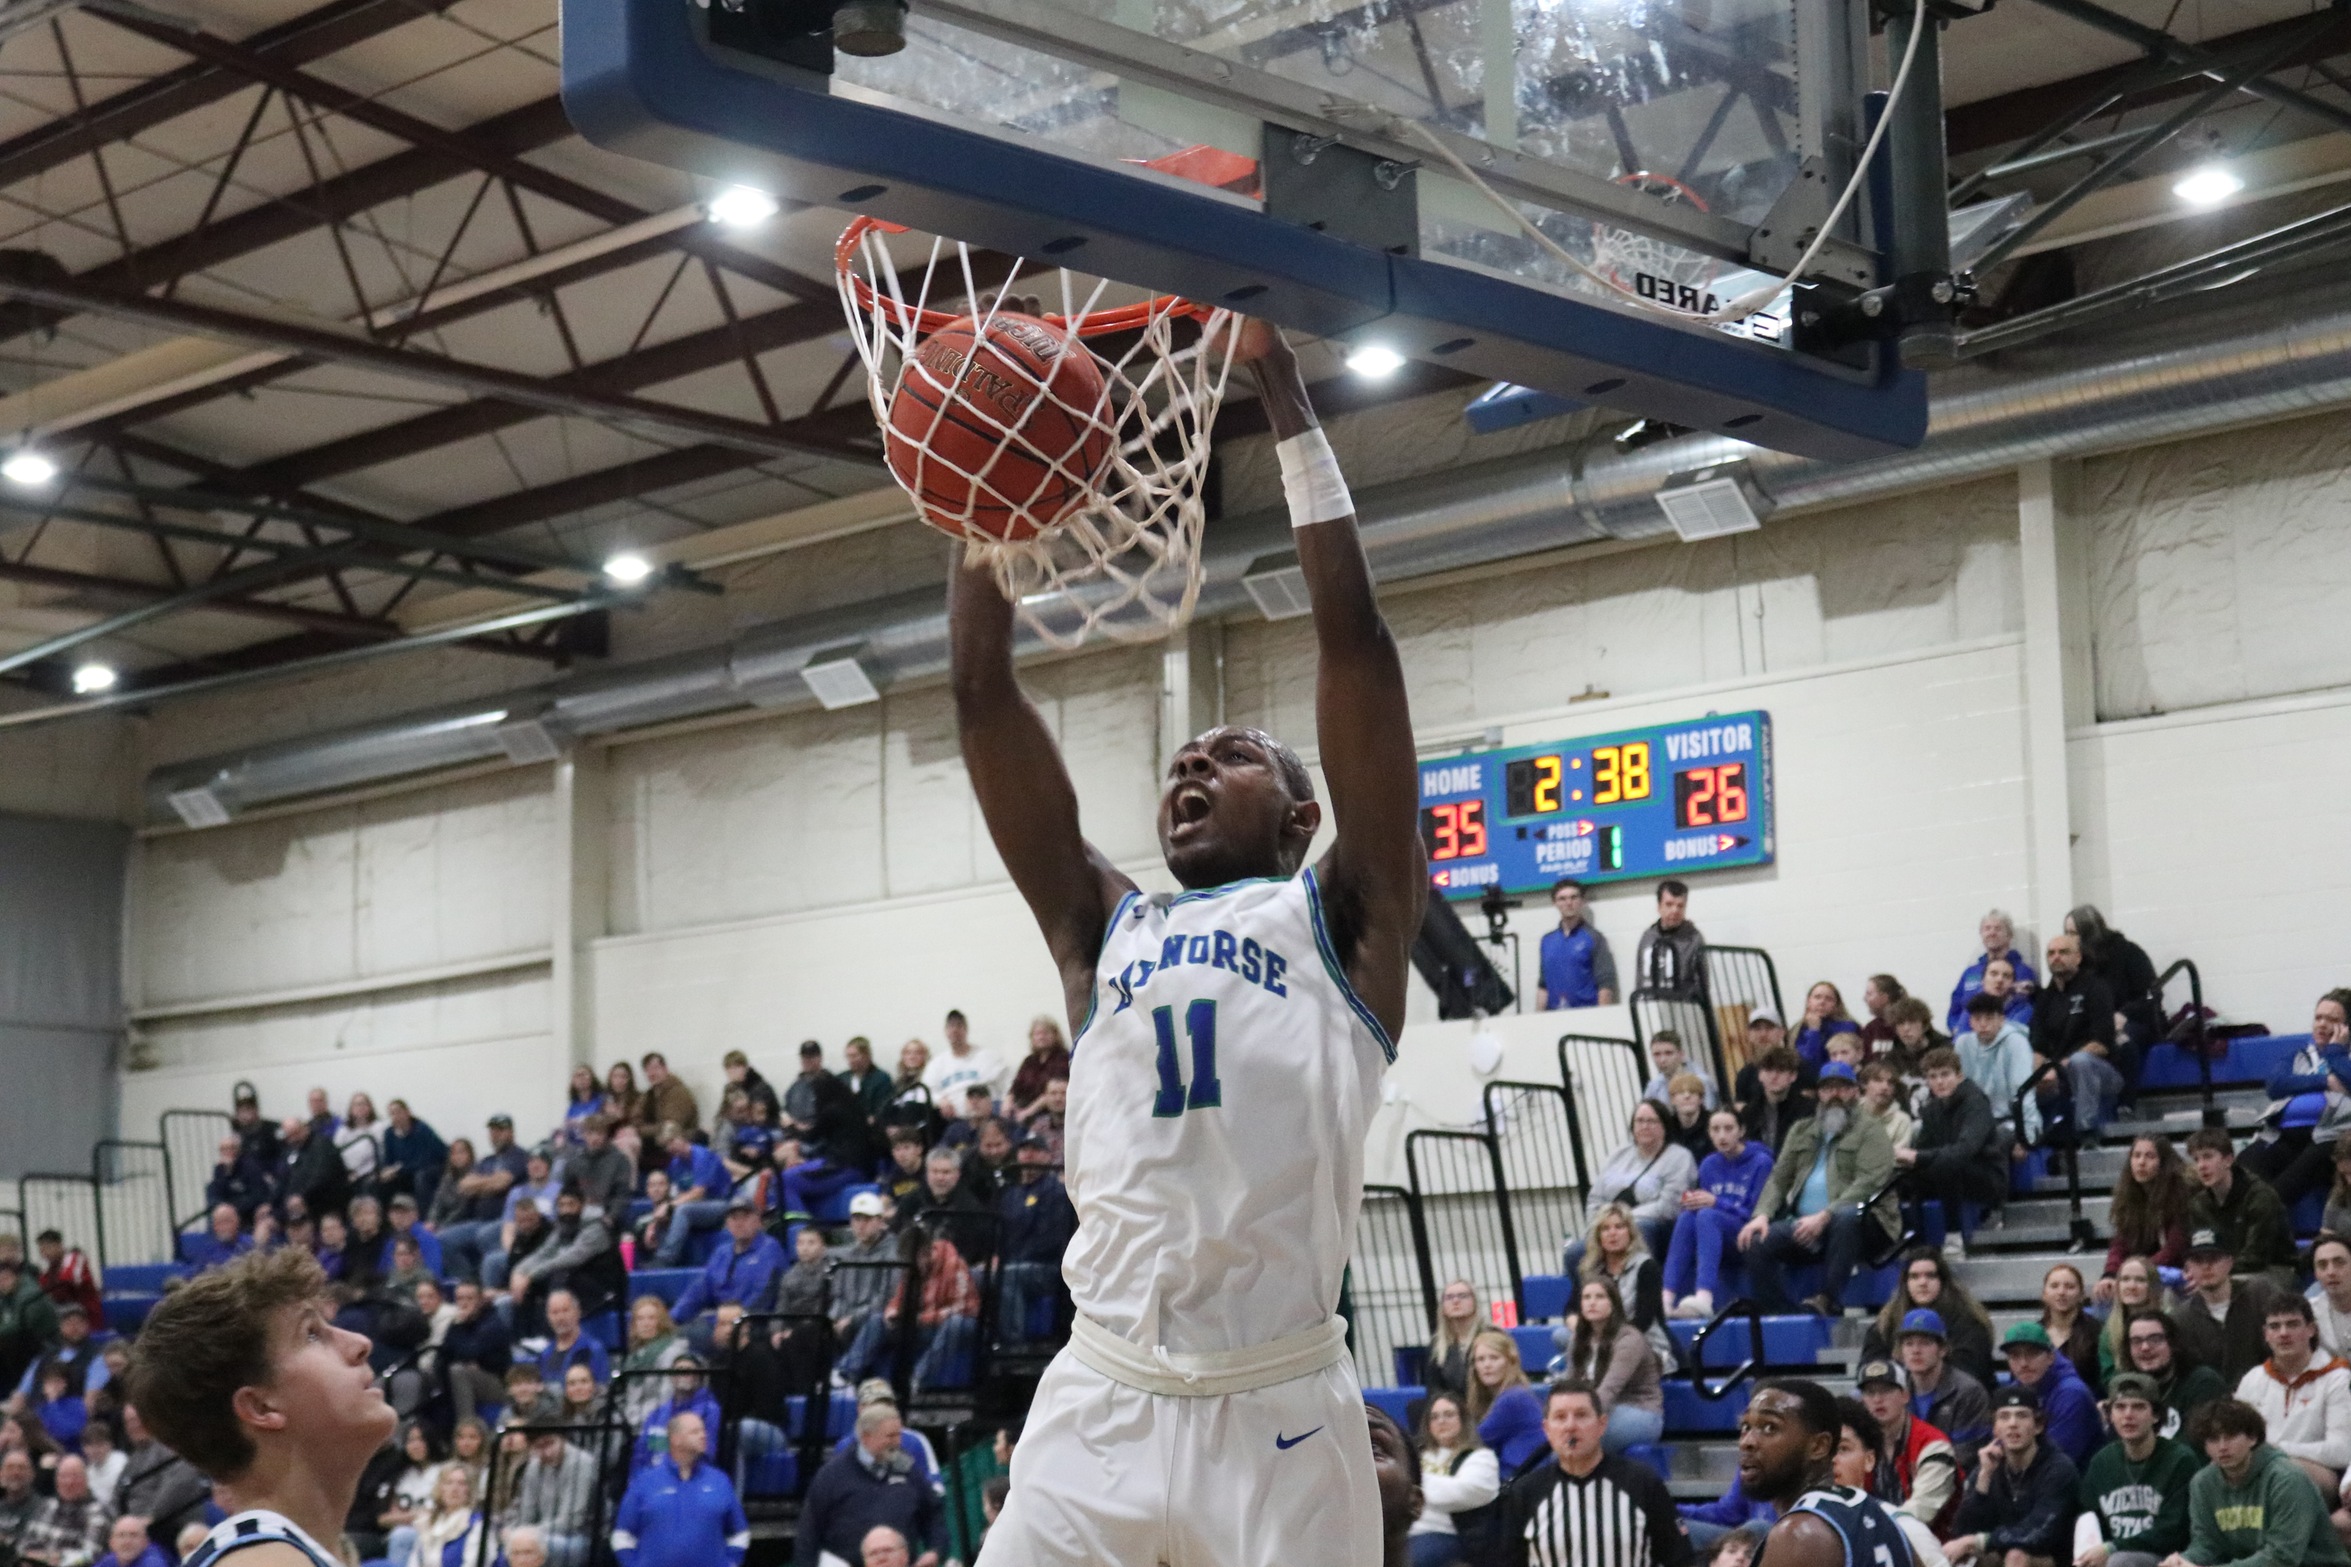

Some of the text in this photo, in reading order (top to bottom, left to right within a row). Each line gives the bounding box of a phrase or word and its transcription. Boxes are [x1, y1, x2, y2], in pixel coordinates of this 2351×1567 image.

[1665, 724, 1752, 761] VISITOR
[1423, 765, 1482, 797] HOME
[1534, 742, 1652, 813] 2:38
[1687, 763, 1747, 826] 26
[1432, 800, 1488, 861] 35
[1535, 838, 1592, 864] PERIOD
[1610, 825, 1622, 870] 1
[1665, 836, 1718, 861] BONUS
[1450, 864, 1498, 888] BONUS
[1151, 998, 1222, 1118] 11
